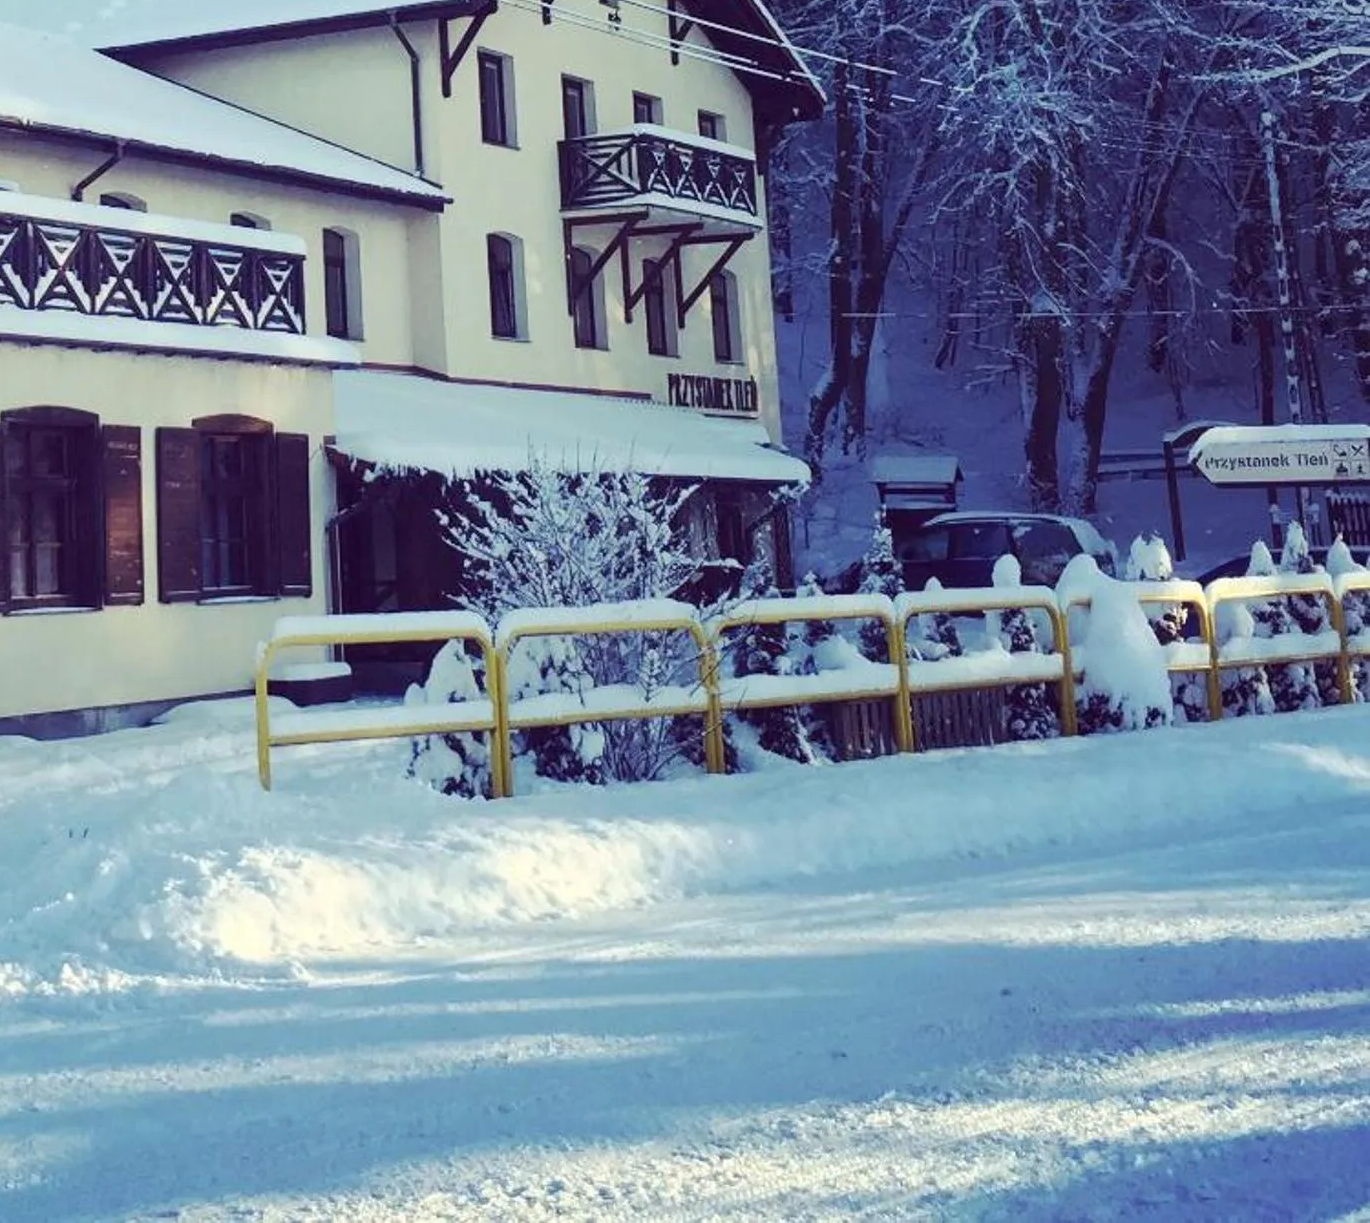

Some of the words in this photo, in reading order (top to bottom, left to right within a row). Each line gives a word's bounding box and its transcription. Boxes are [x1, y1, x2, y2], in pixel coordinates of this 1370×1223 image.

[667, 373, 734, 410] PRZYSTANEK
[1204, 453, 1290, 471] Przystanek
[1295, 451, 1329, 467] Tleń
